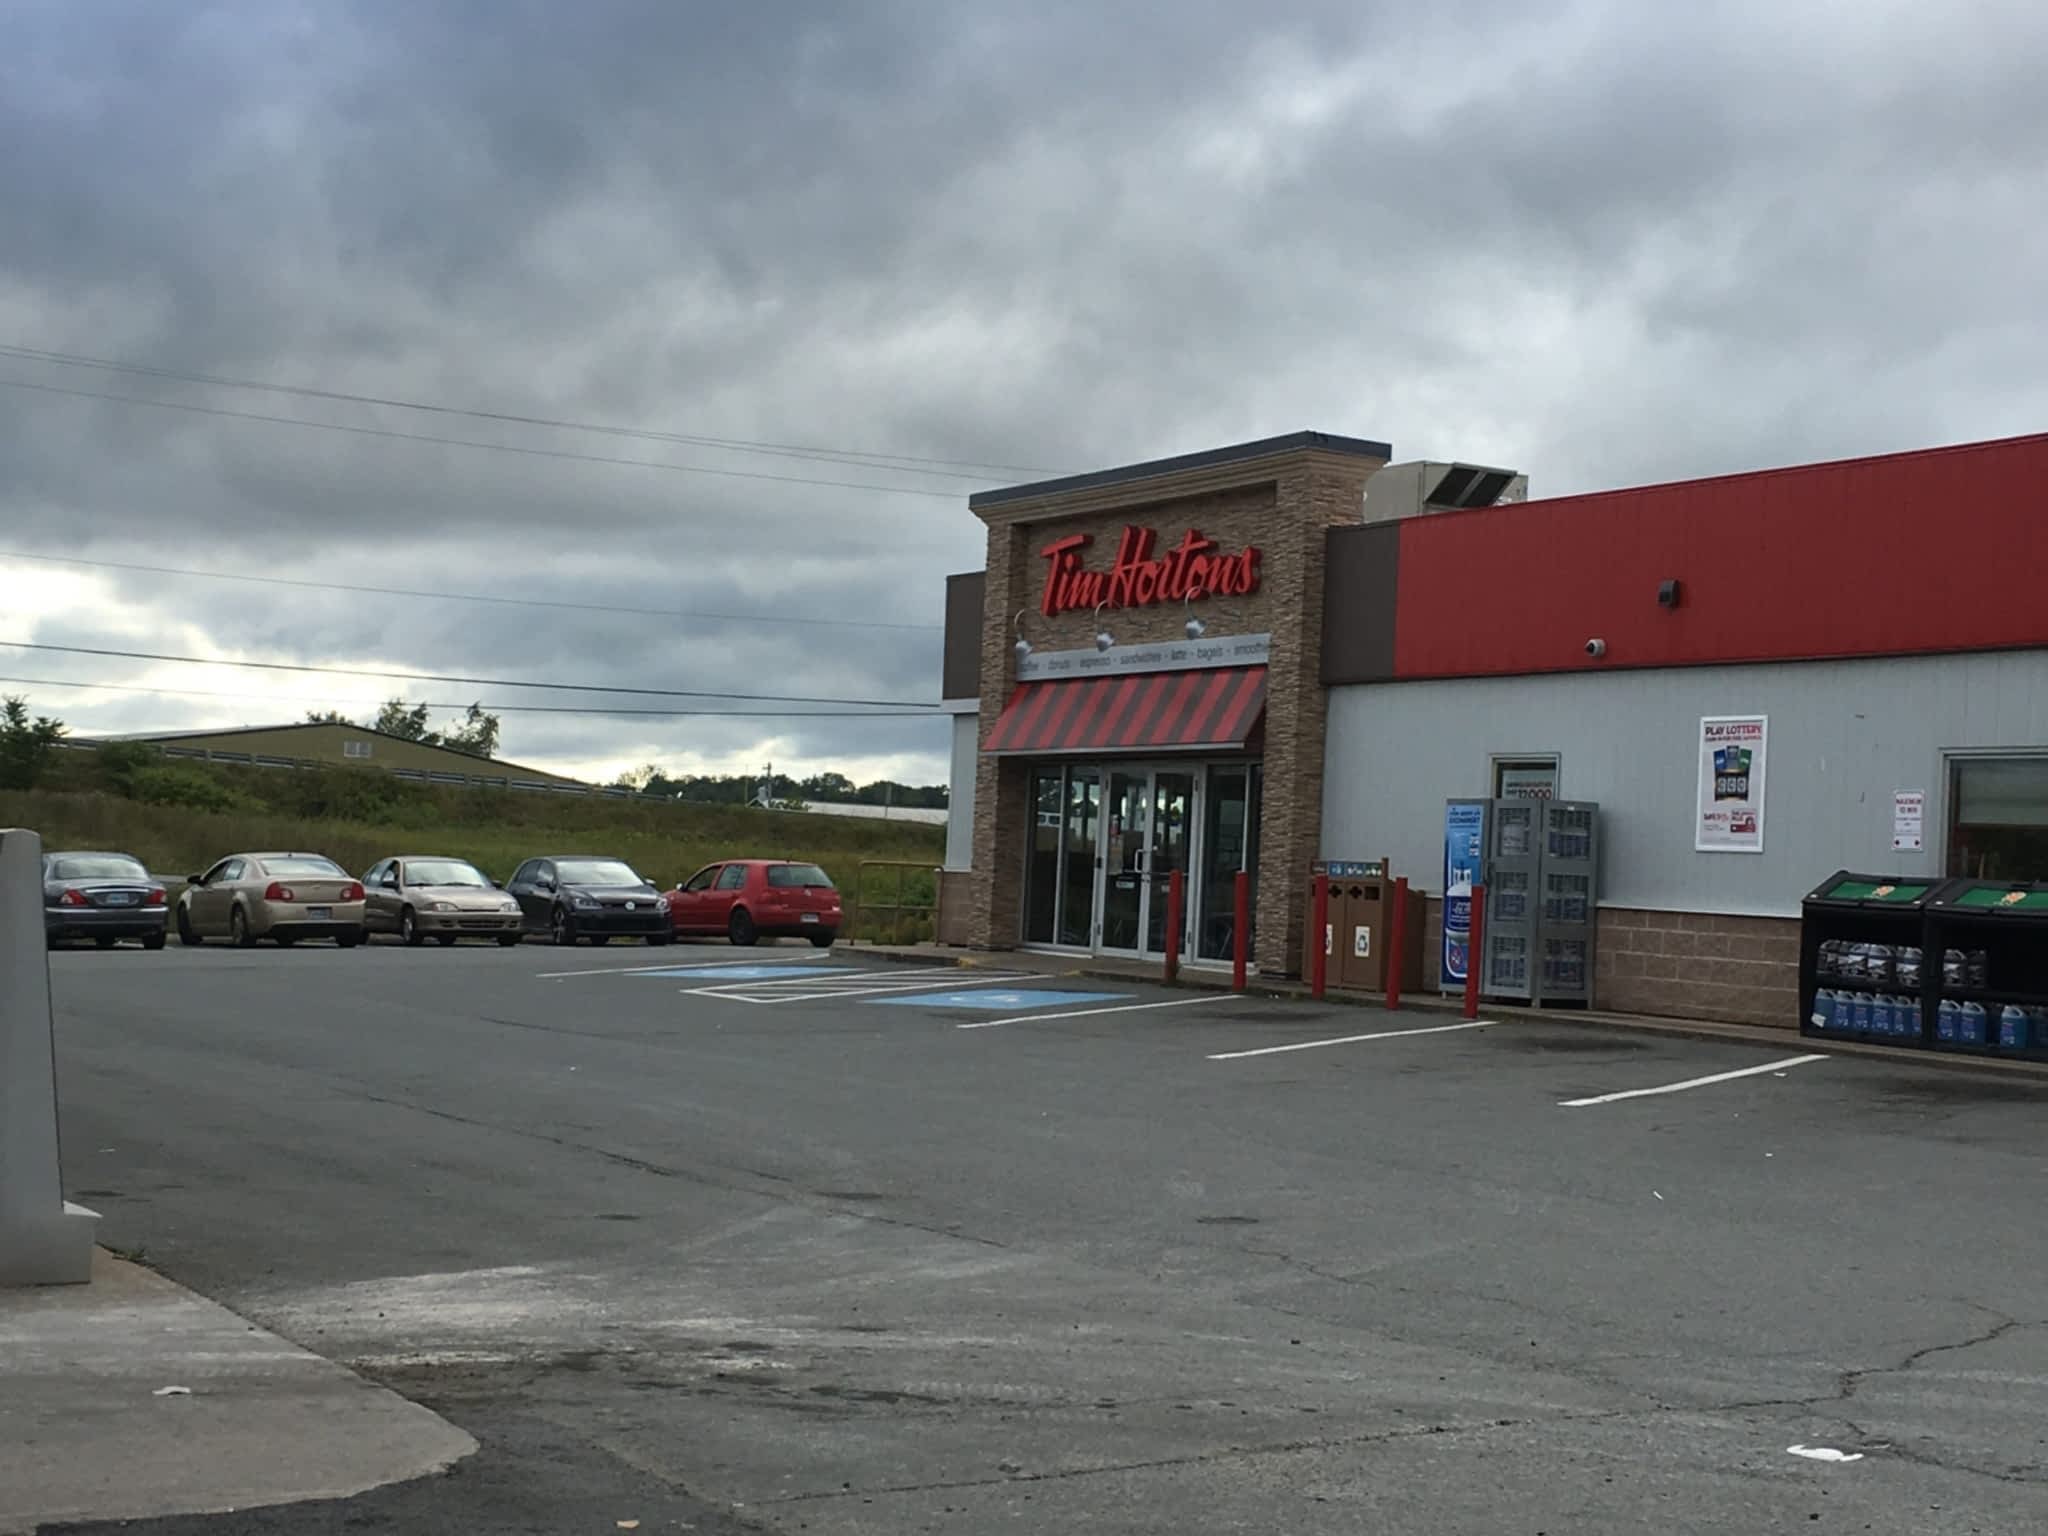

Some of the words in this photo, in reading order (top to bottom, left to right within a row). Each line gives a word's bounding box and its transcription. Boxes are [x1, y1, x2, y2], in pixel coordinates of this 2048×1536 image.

[1040, 532, 1105, 617] Tim
[1106, 524, 1262, 608] Hortons
[1704, 725, 1725, 736] PLAY
[1726, 723, 1762, 736] LOTTERY
